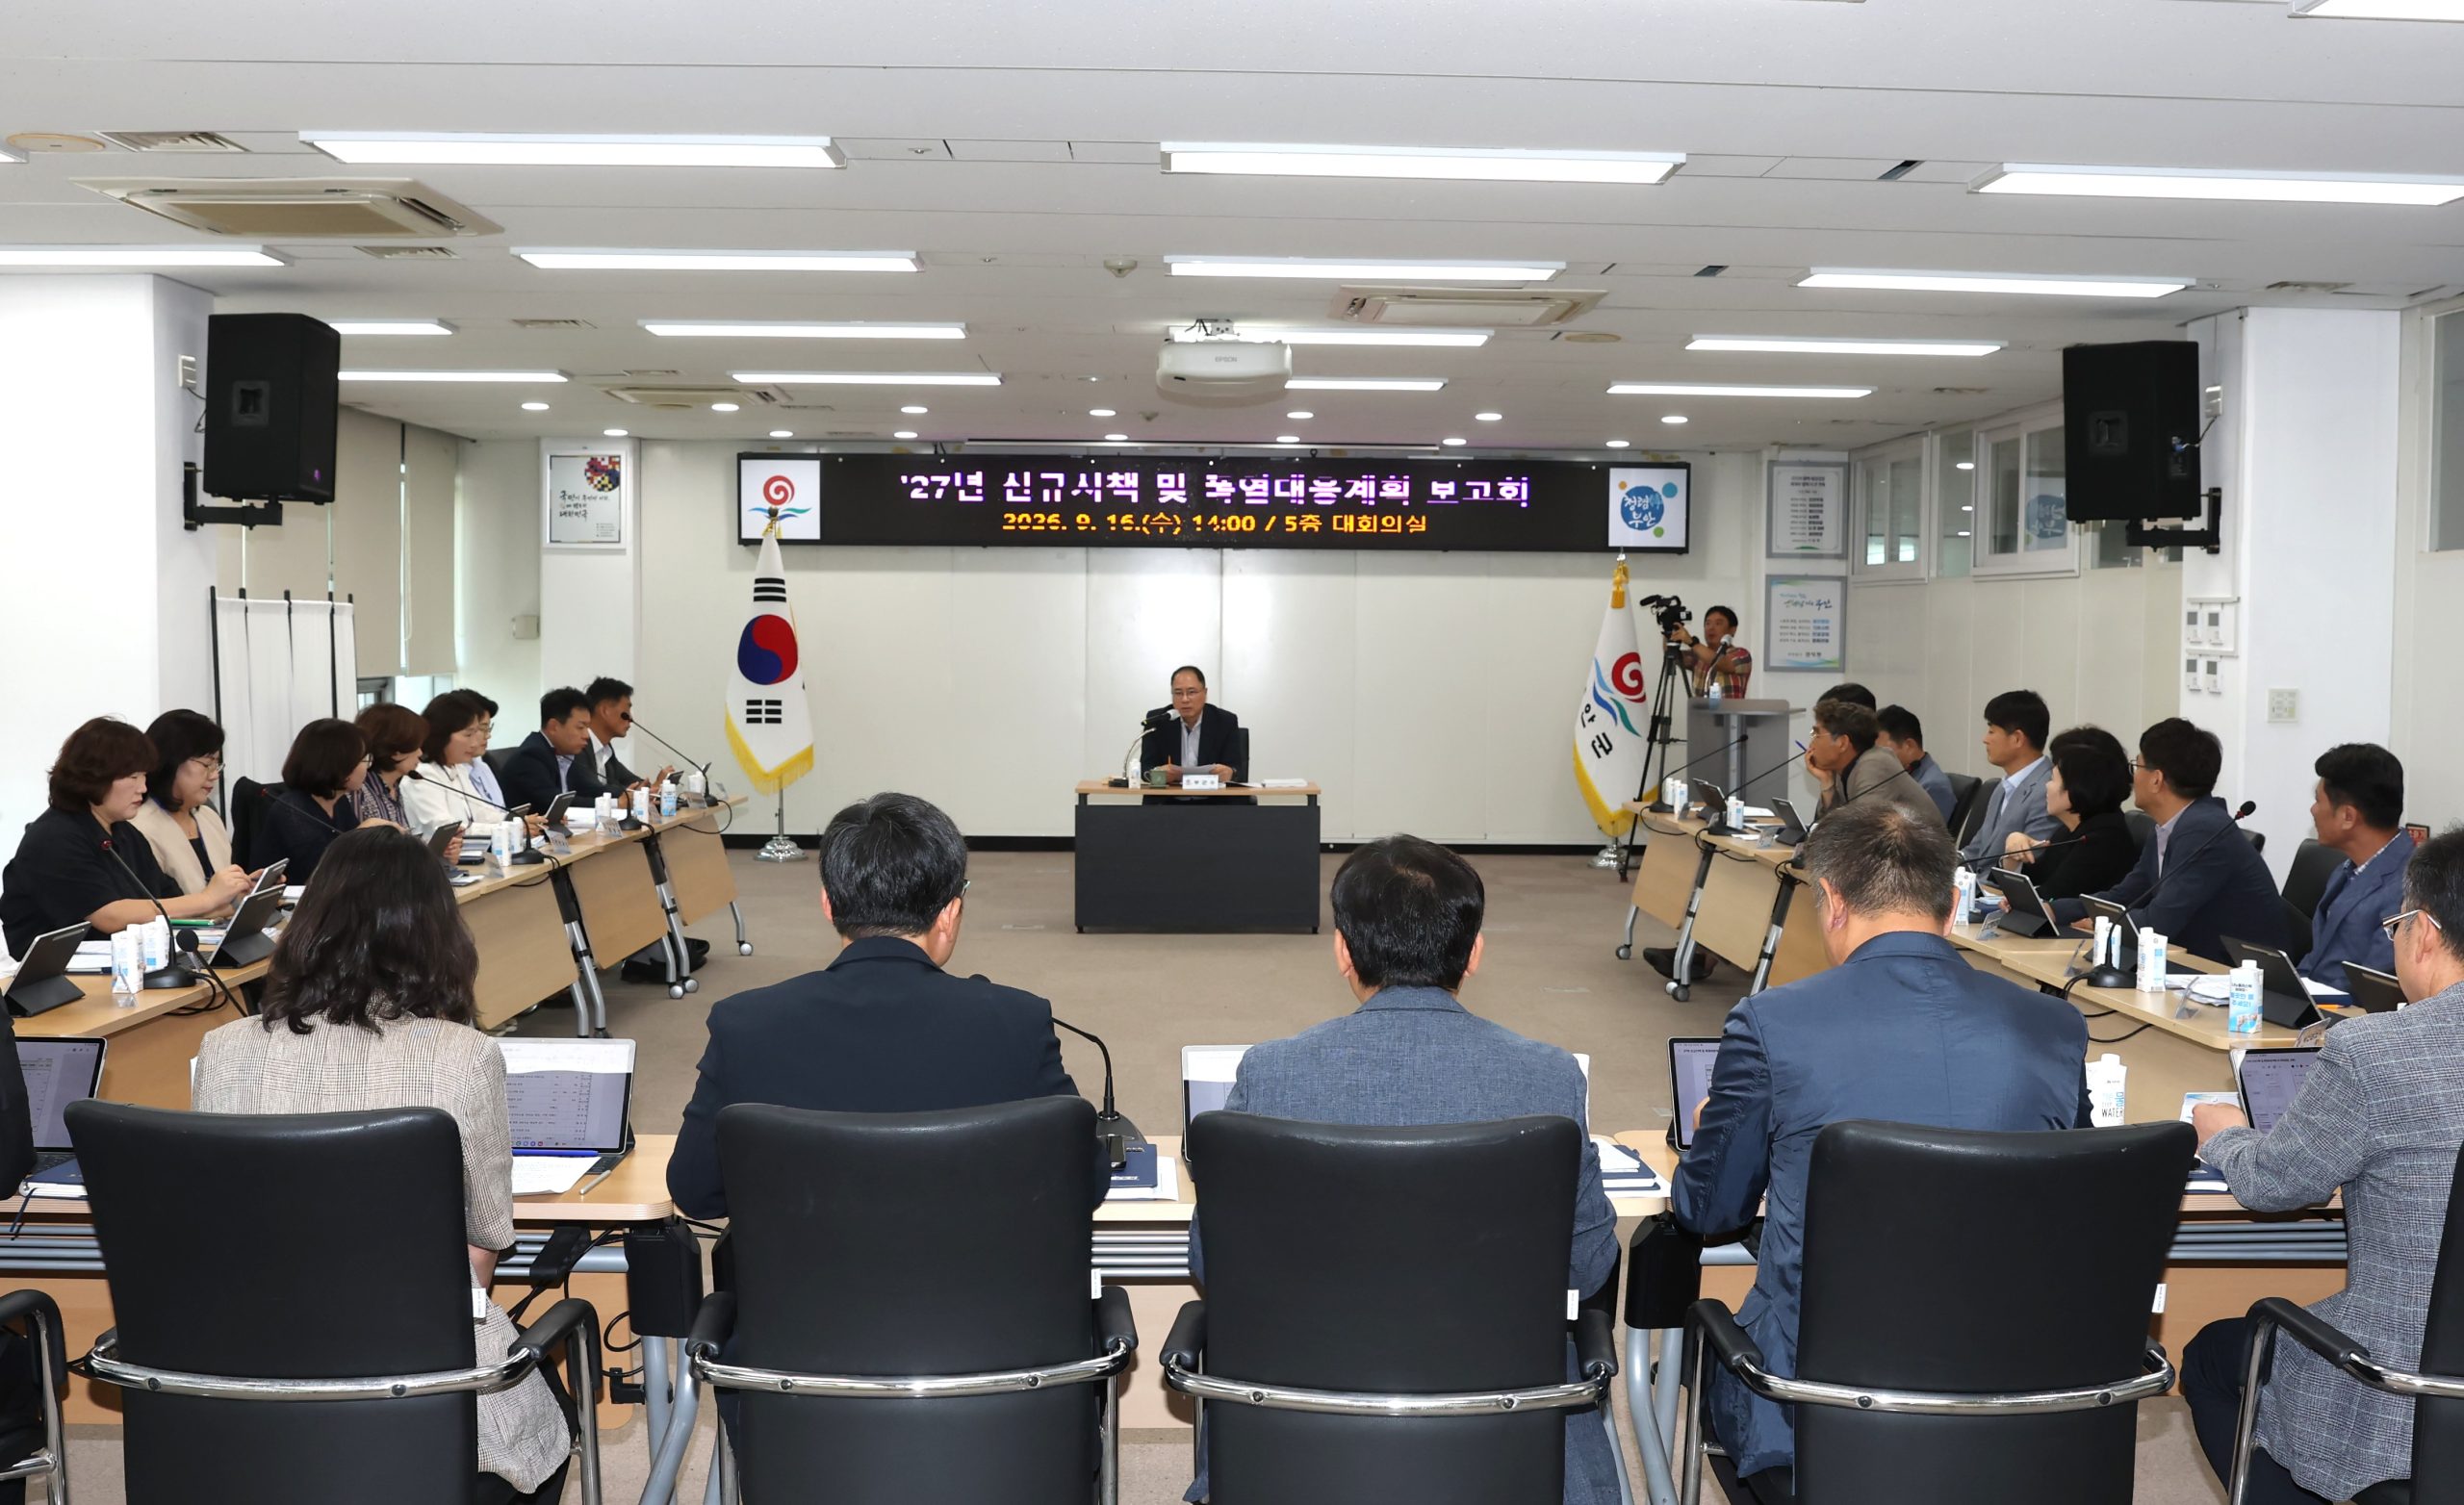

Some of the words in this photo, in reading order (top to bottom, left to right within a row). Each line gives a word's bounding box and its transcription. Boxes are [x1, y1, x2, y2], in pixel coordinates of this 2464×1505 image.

[900, 471, 984, 501] '27년
[1002, 471, 1139, 502] 신규시책
[1156, 472, 1188, 503] 및
[1426, 476, 1528, 507] 보고회
[1002, 513, 1067, 531] 2026.
[1264, 515, 1277, 531] /
[1285, 514, 1323, 532] 5층
[1332, 514, 1427, 533] 대회의실
[1629, 511, 1656, 528] 부안
